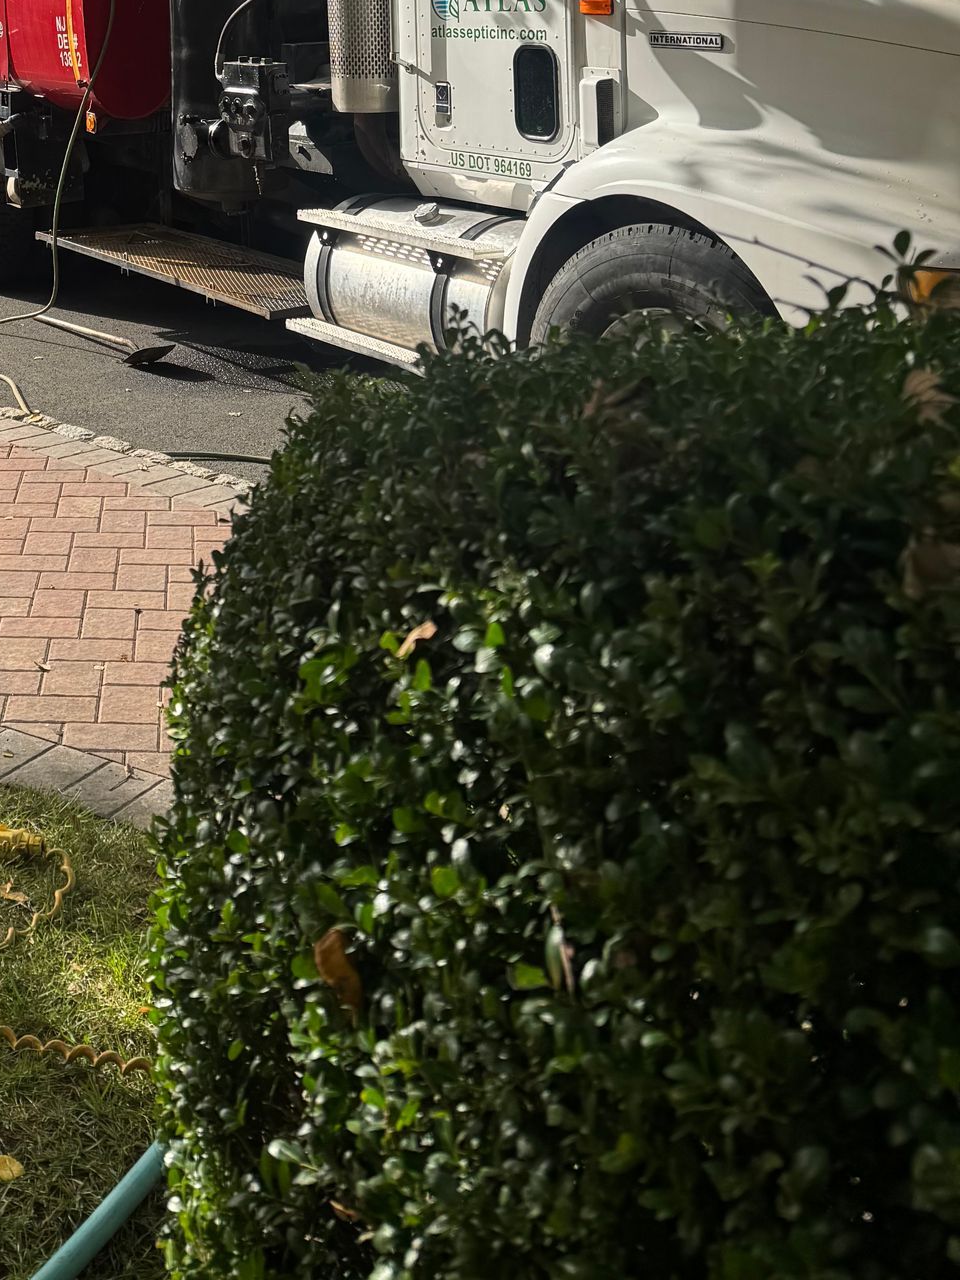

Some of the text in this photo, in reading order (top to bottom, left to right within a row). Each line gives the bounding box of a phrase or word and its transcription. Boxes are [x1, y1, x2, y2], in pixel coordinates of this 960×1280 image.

[55, 16, 66, 32] NJ
[57, 33, 79, 50] DE#
[431, 24, 548, 43] atlassepticinc.com
[650, 35, 720, 46] INTERNATIONAL
[60, 51, 83, 68] 1382
[451, 152, 532, 178] US DOT 964169
